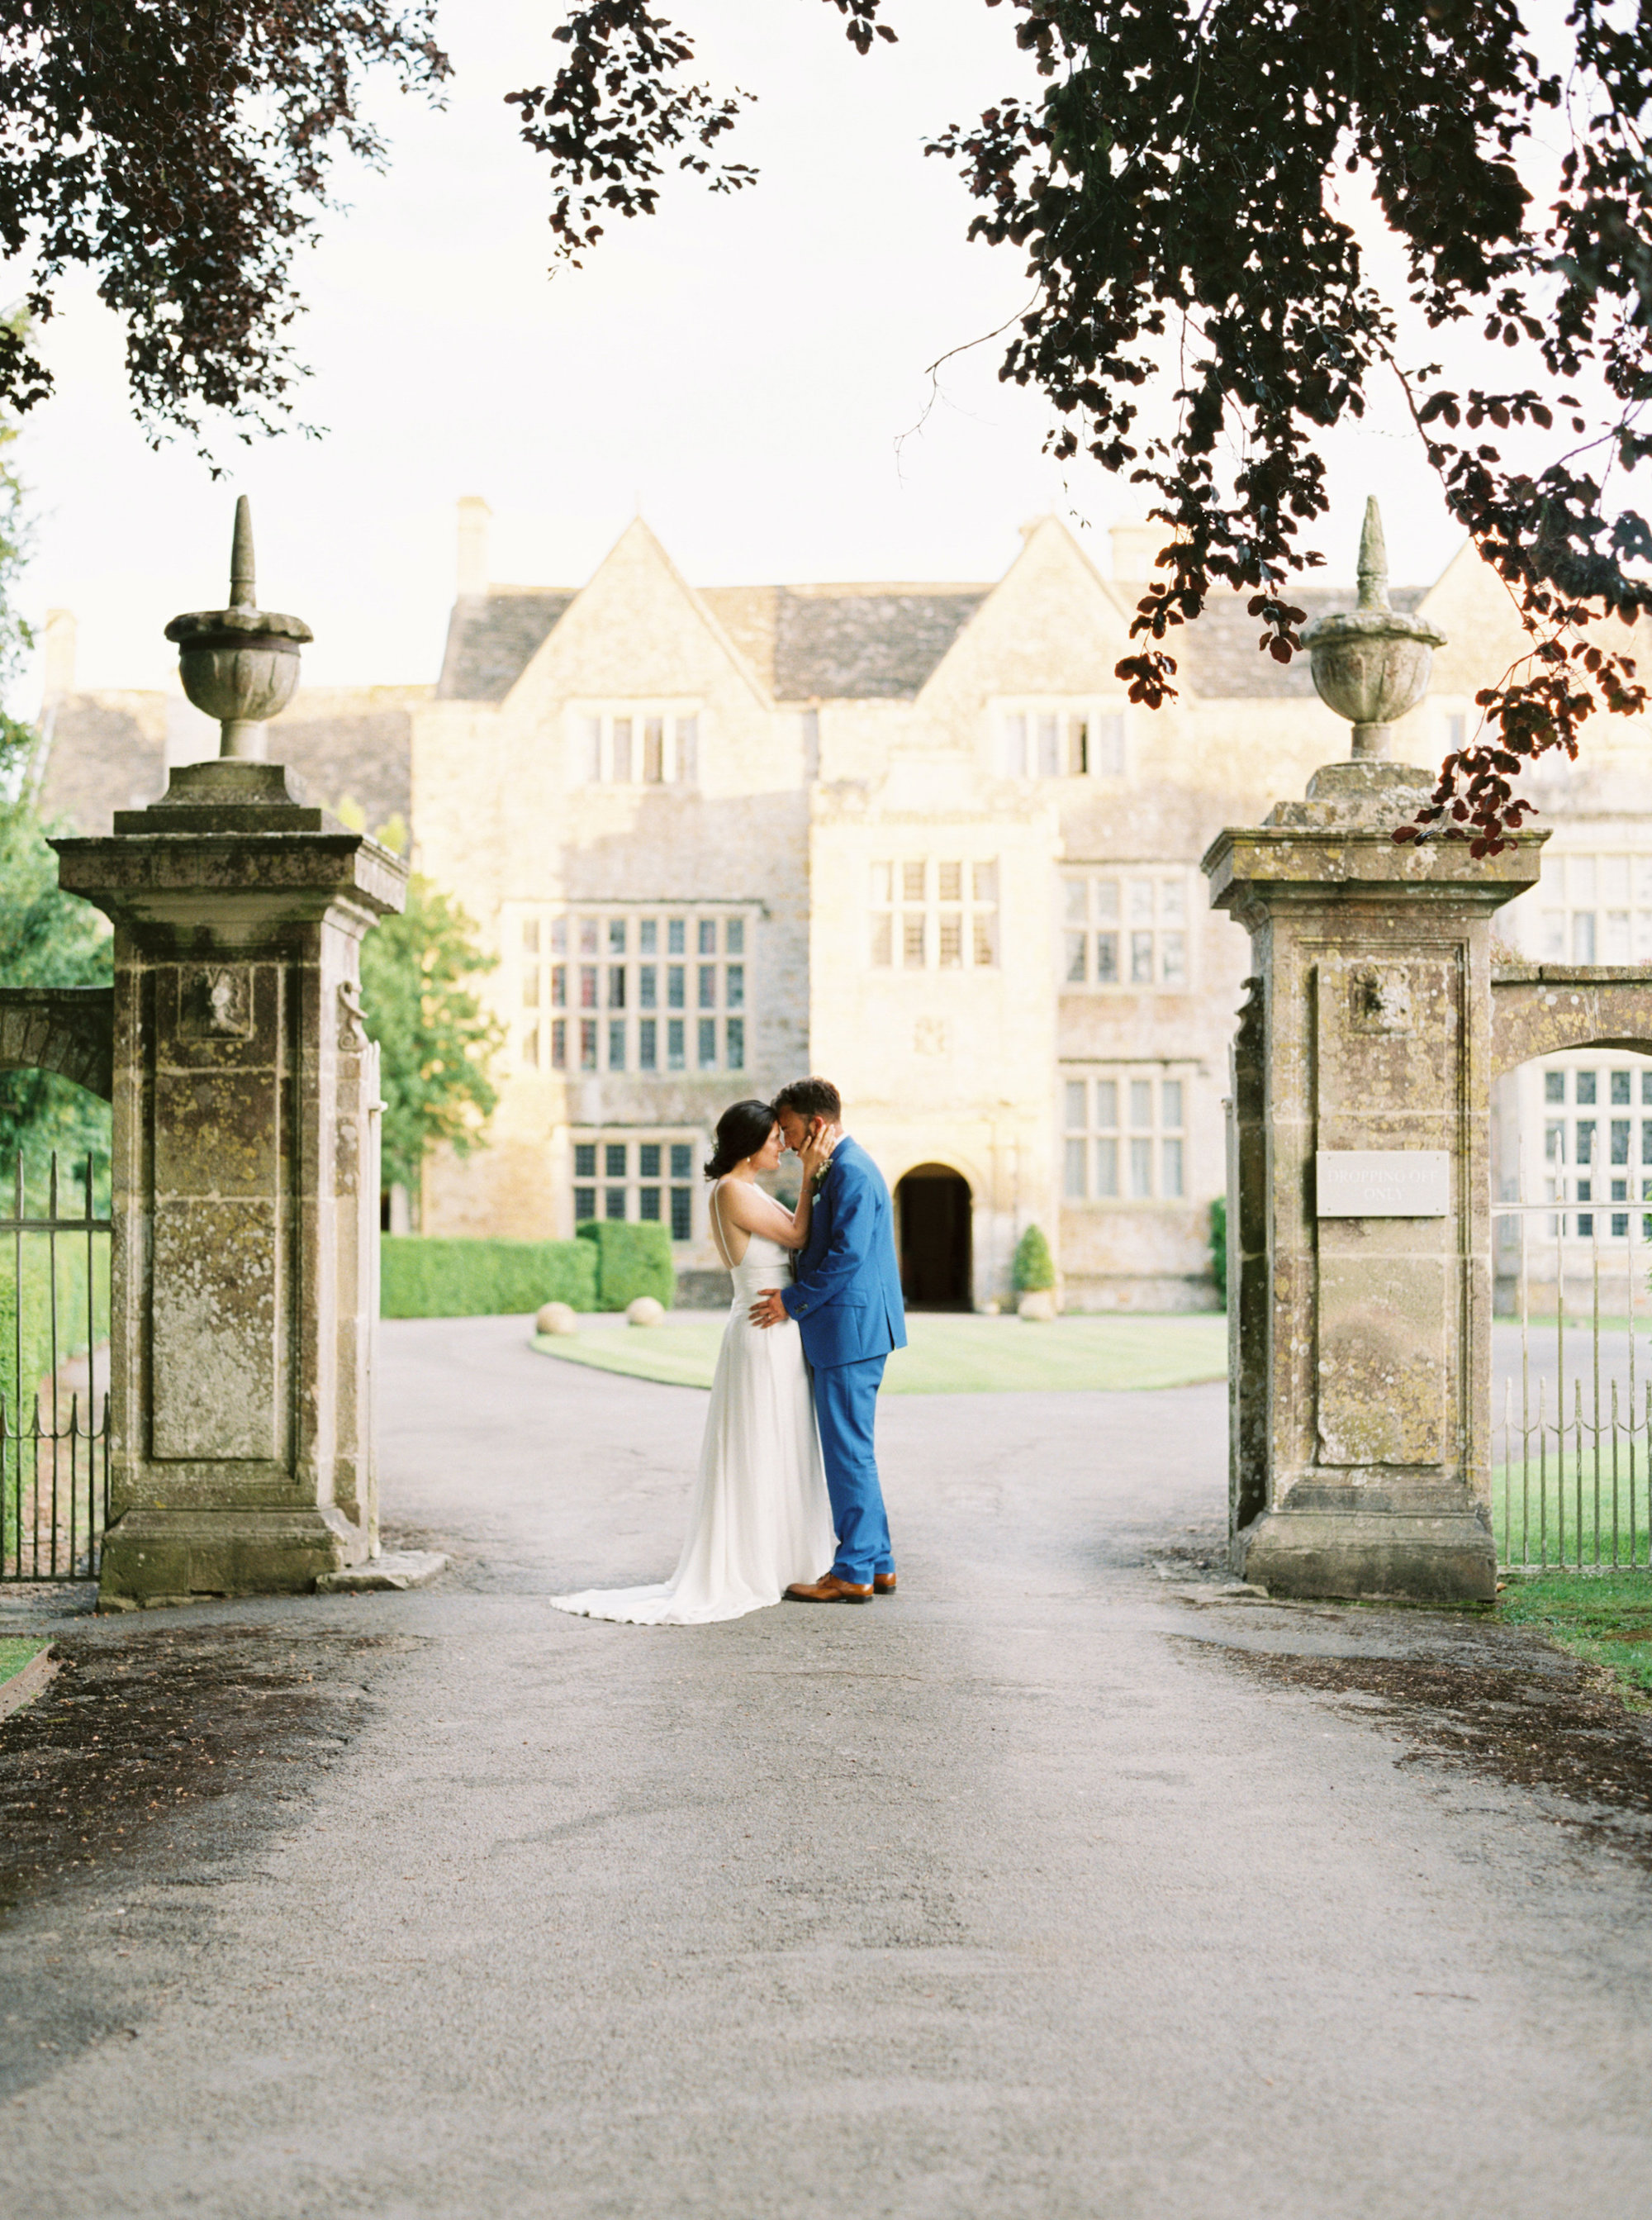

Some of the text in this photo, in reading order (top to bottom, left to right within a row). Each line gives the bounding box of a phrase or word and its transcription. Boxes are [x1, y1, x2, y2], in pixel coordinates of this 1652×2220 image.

[1328, 1169, 1438, 1183] DROPPING OFF
[1364, 1187, 1403, 1201] ONLY
